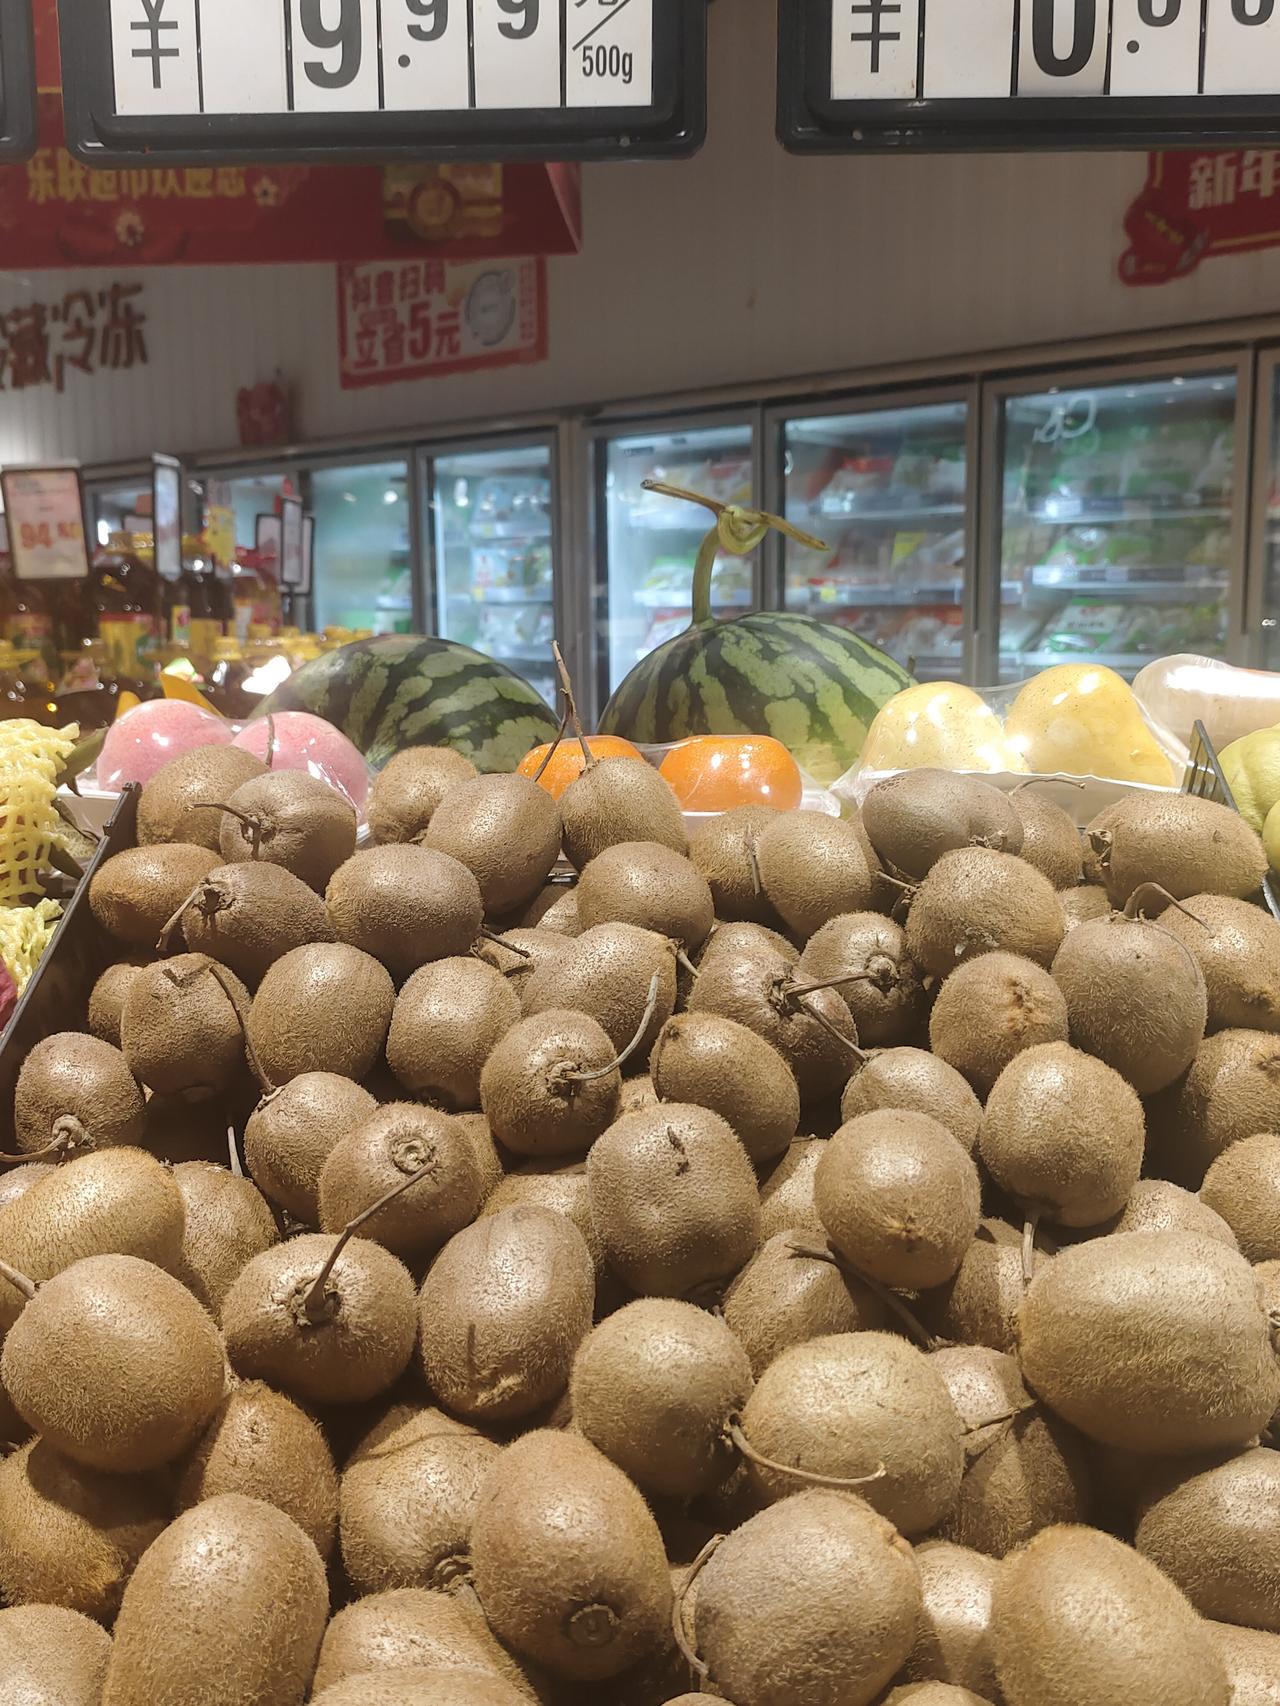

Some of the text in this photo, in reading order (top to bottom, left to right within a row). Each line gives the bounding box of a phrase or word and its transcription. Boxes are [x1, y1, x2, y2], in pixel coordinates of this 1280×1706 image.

[582, 45, 633, 84] 500g
[0, 282, 149, 394] 藏冷冻
[353, 301, 462, 370] 立省5元
